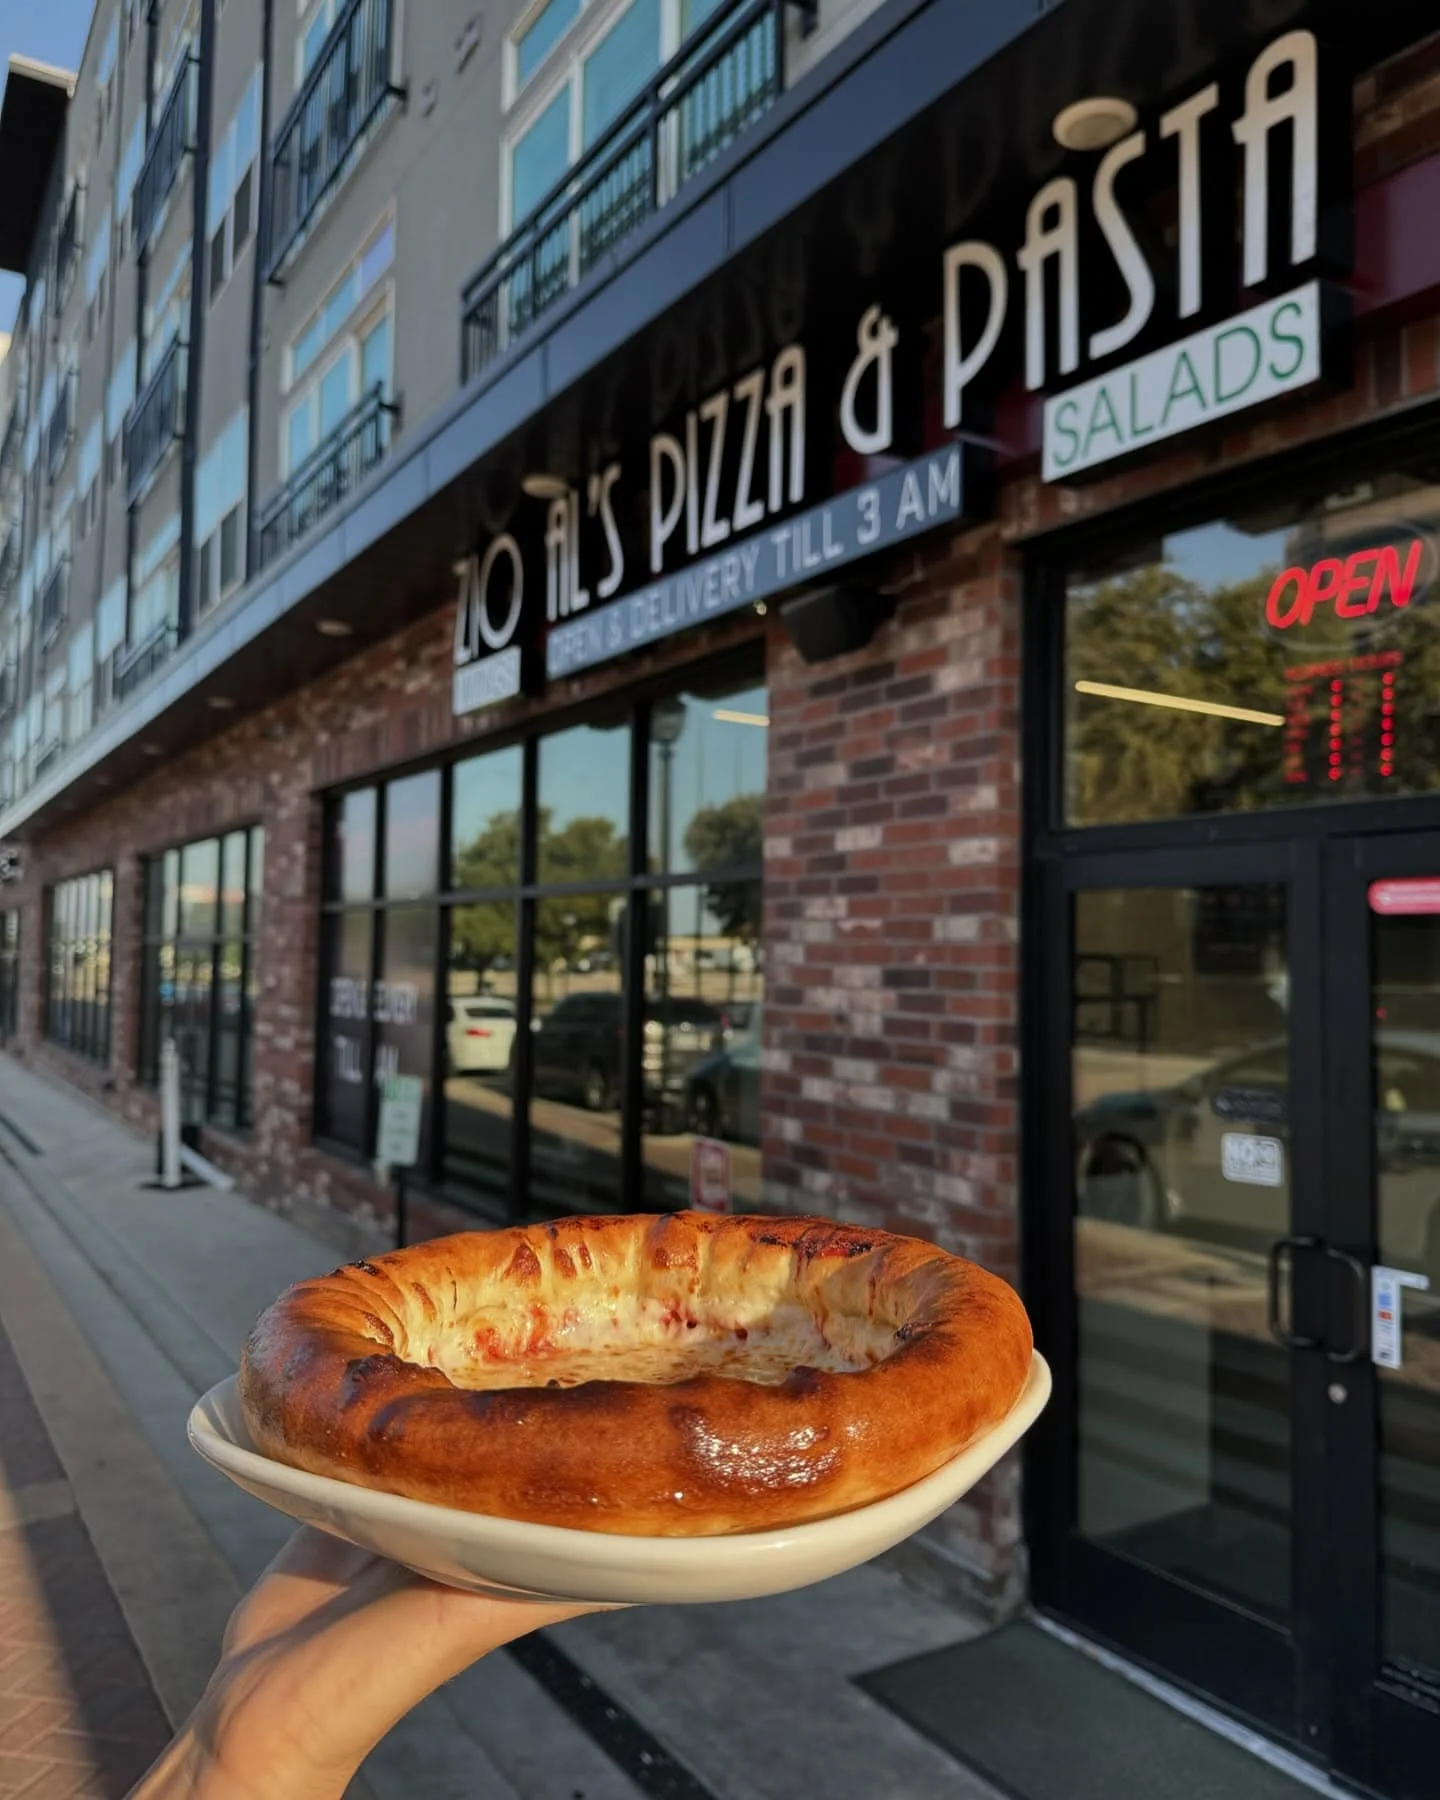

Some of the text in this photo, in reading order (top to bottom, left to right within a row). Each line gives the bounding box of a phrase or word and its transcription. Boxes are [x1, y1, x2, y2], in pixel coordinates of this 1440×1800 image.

[453, 30, 1318, 665] ZIO AL'S PIZZA & PASTA
[1052, 302, 1305, 468] SALADS
[629, 545, 760, 638] DELIVERY
[771, 509, 844, 578] TILL
[857, 487, 880, 545] 3
[896, 452, 961, 530] AM
[1266, 540, 1423, 628] OPEN
